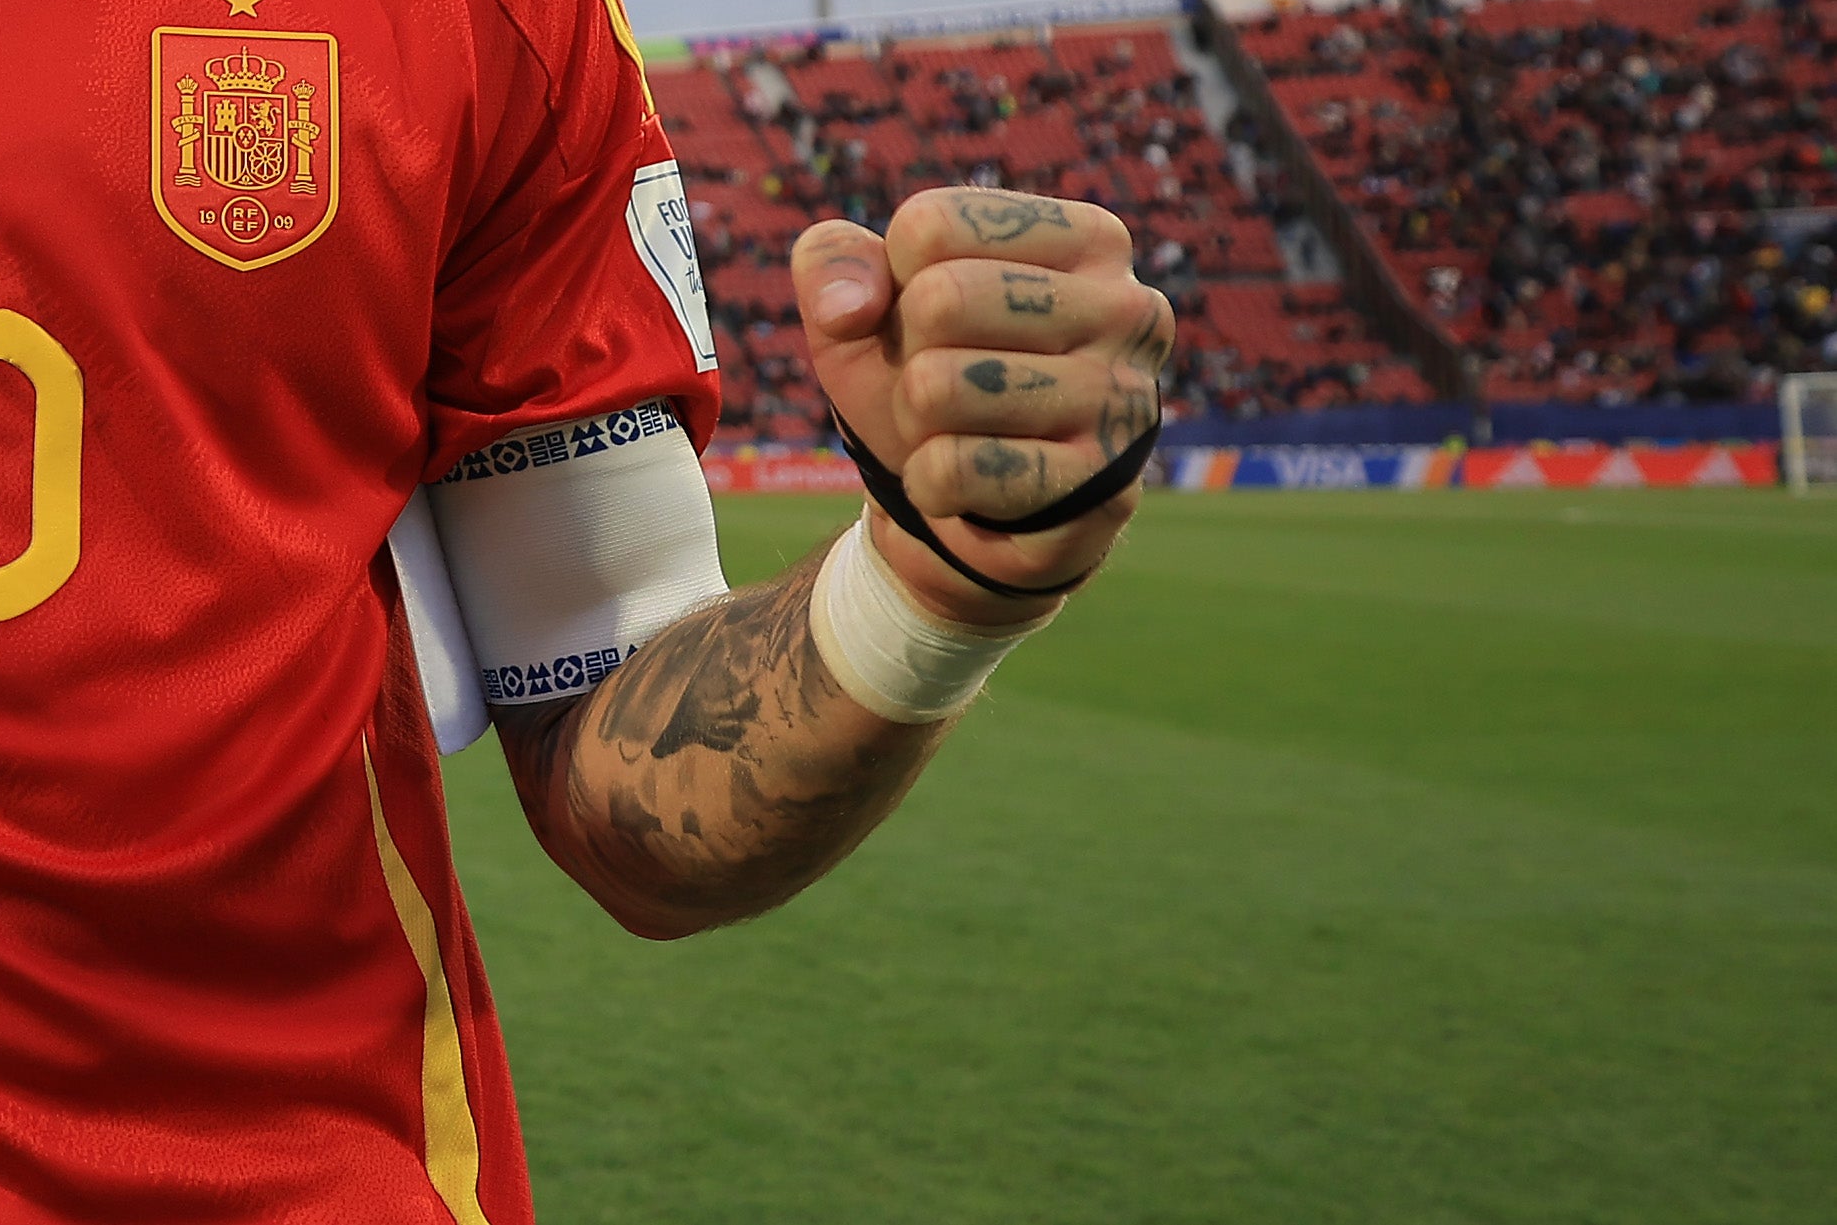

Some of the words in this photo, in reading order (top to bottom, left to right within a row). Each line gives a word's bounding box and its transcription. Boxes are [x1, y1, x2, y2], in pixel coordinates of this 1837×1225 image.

[199, 210, 216, 224] 19
[232, 207, 258, 219] RF
[232, 220, 258, 232] EF
[274, 215, 294, 229] 09
